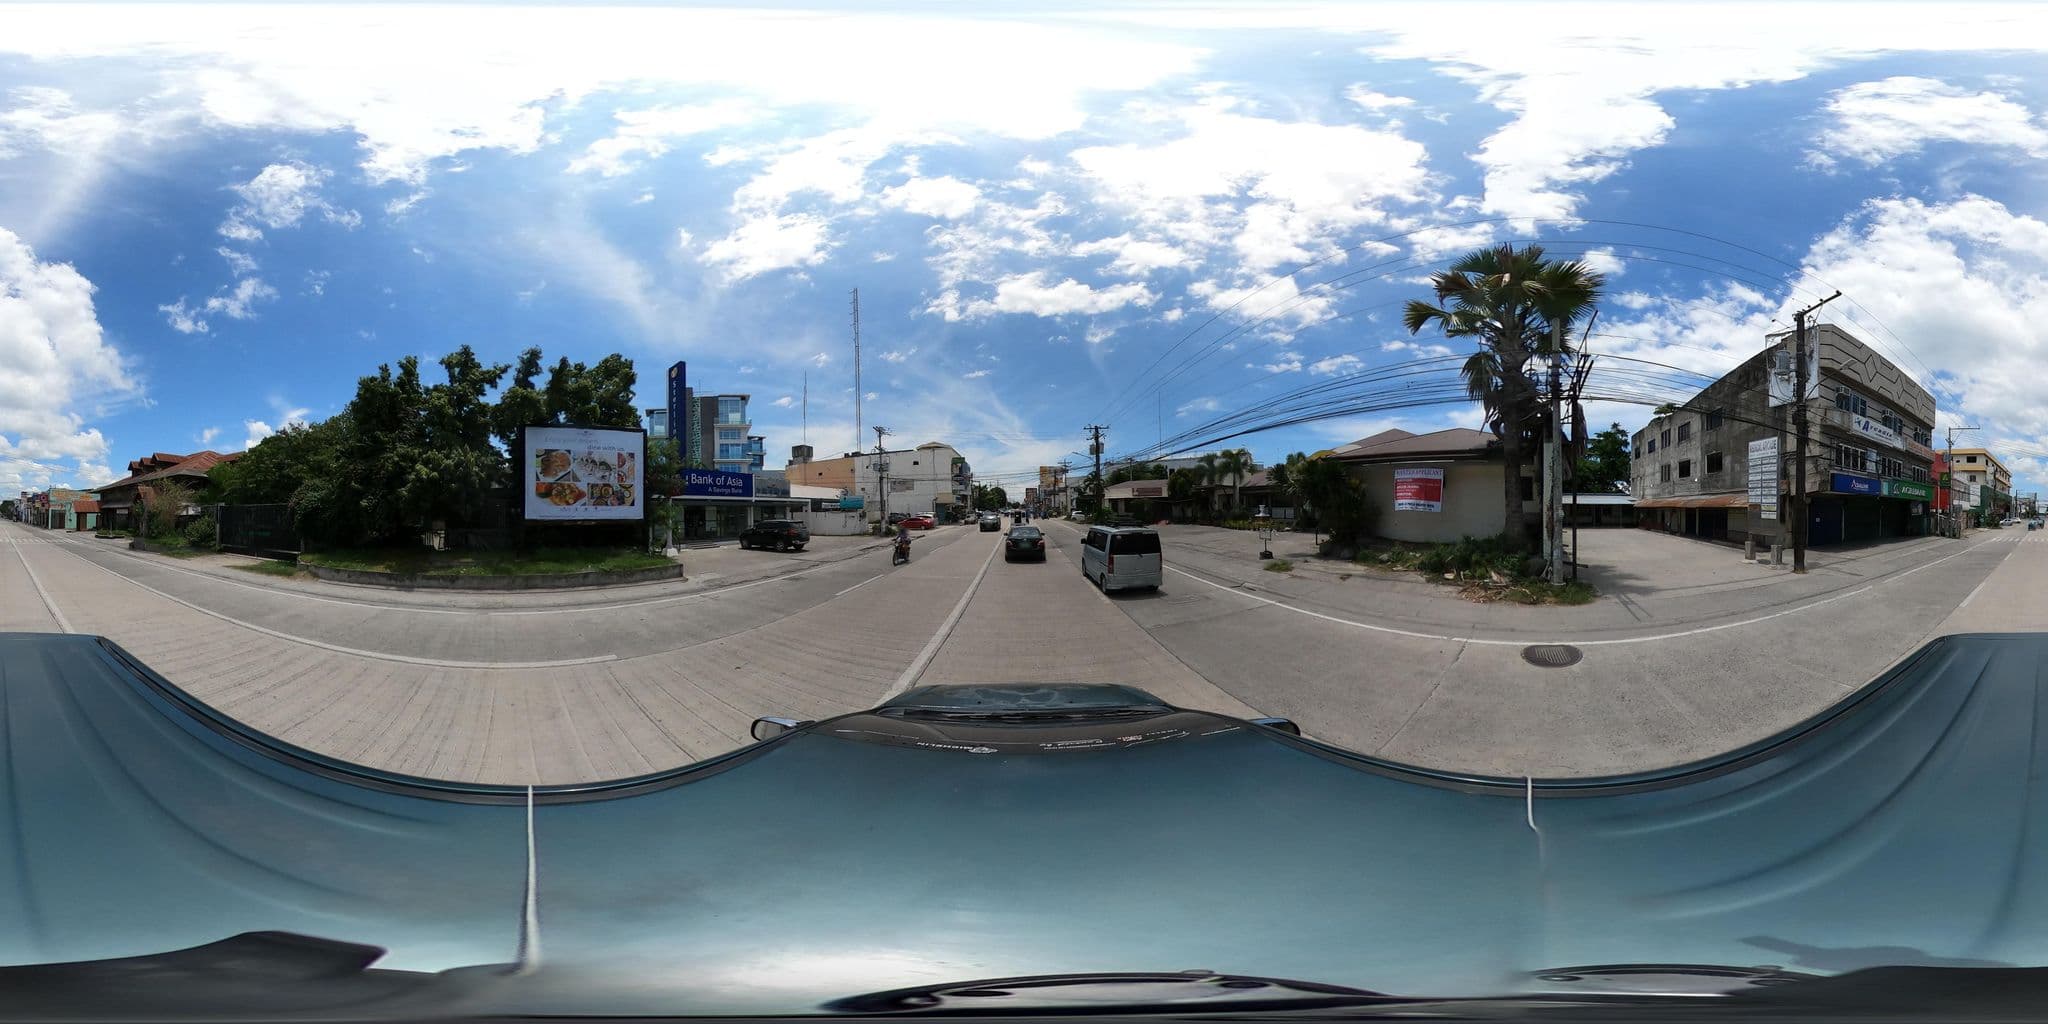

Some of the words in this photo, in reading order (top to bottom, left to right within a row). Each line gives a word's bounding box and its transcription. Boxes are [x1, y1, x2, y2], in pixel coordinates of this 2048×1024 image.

[691, 473, 713, 485] Bank
[715, 475, 725, 486] of
[726, 476, 743, 487] Asia
